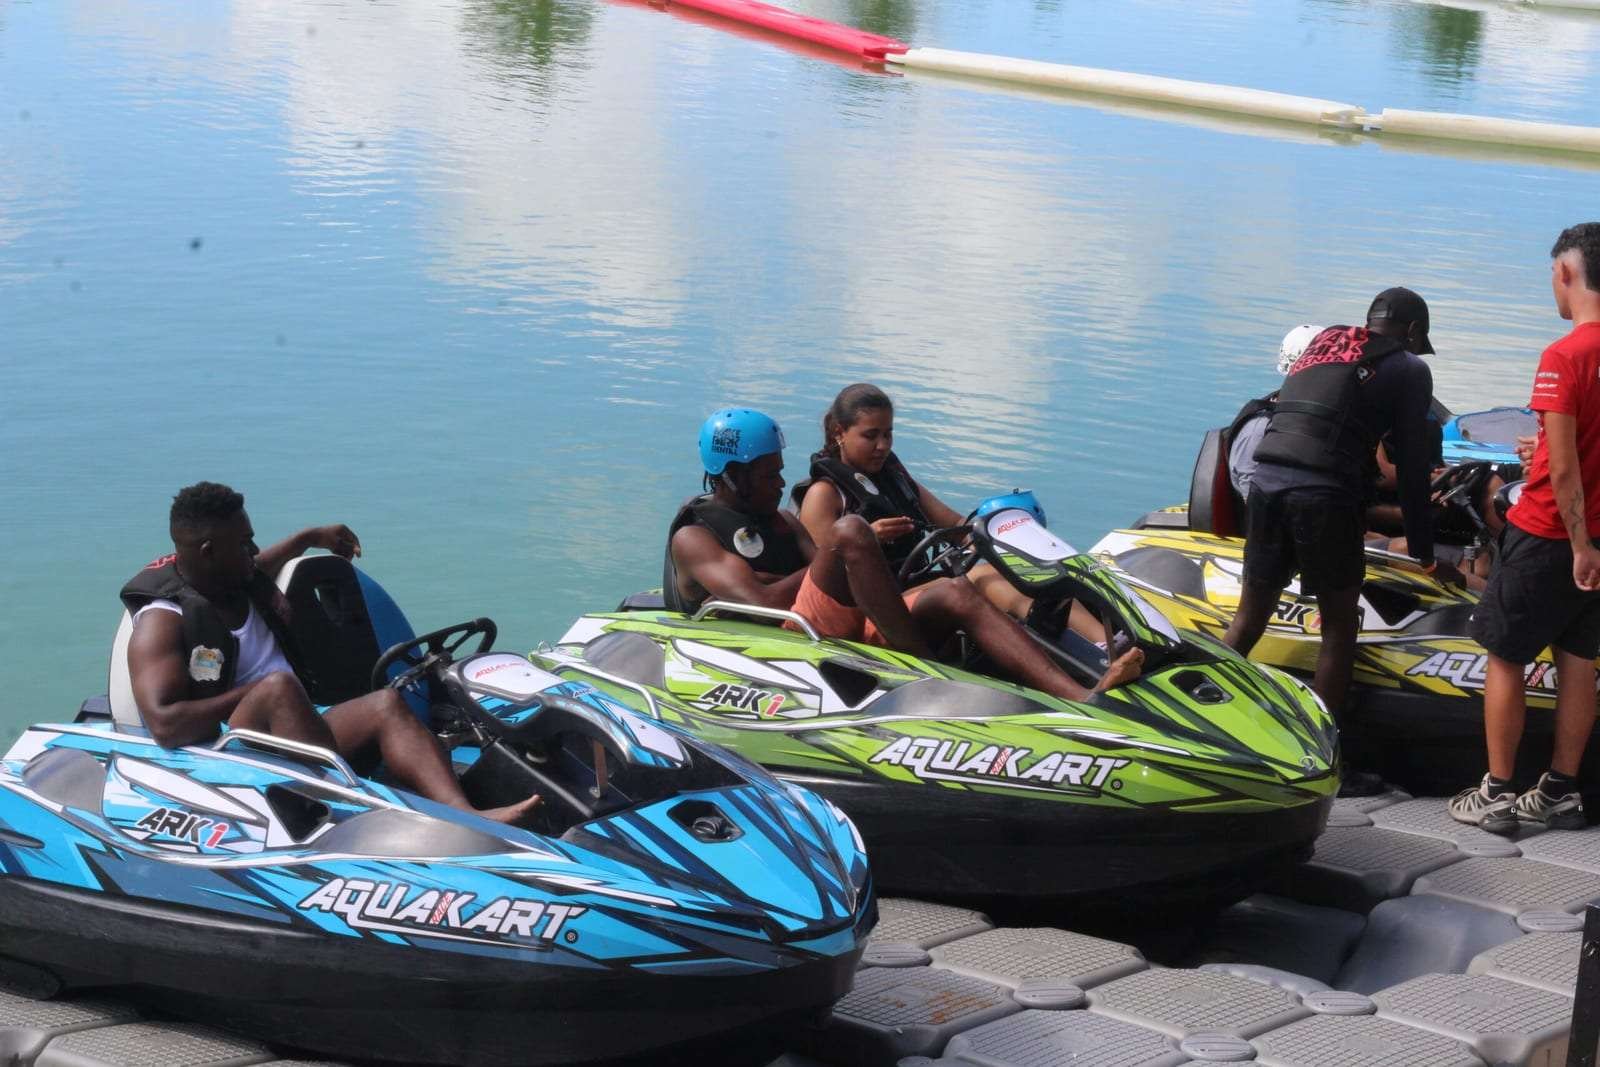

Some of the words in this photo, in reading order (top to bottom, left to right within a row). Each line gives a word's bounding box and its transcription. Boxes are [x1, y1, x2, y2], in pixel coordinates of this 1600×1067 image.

[1271, 600, 1314, 626] RK
[869, 736, 1130, 795] AQUAKART
[301, 878, 588, 948] AQUAKART
